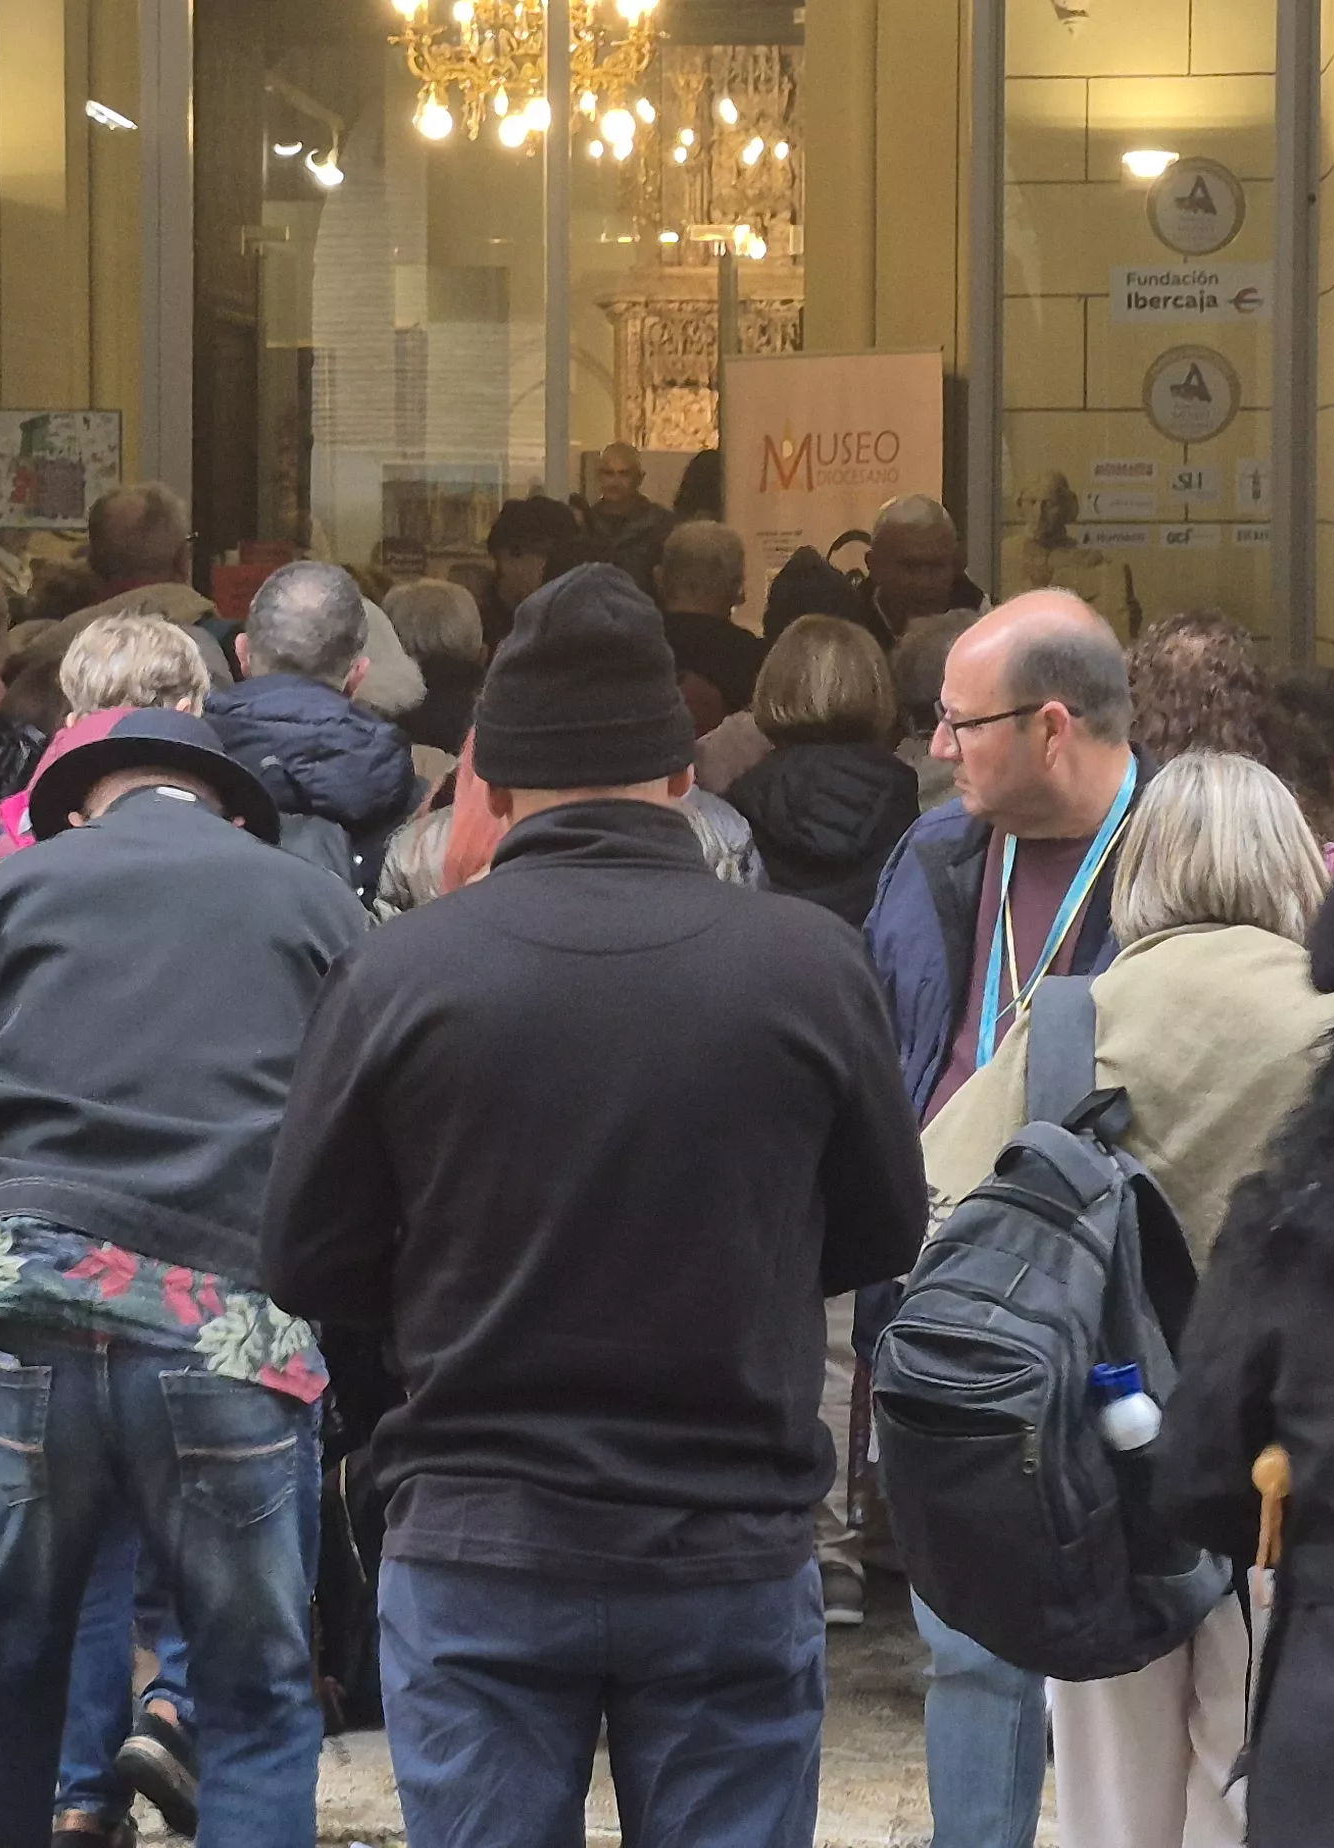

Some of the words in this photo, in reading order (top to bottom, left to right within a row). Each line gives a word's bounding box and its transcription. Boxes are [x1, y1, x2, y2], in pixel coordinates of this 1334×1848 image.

[1126, 269, 1220, 287] Fundación
[1126, 288, 1220, 314] Ibercaja
[760, 429, 901, 493] MUSEO
[816, 467, 900, 486] DIOCESANO
